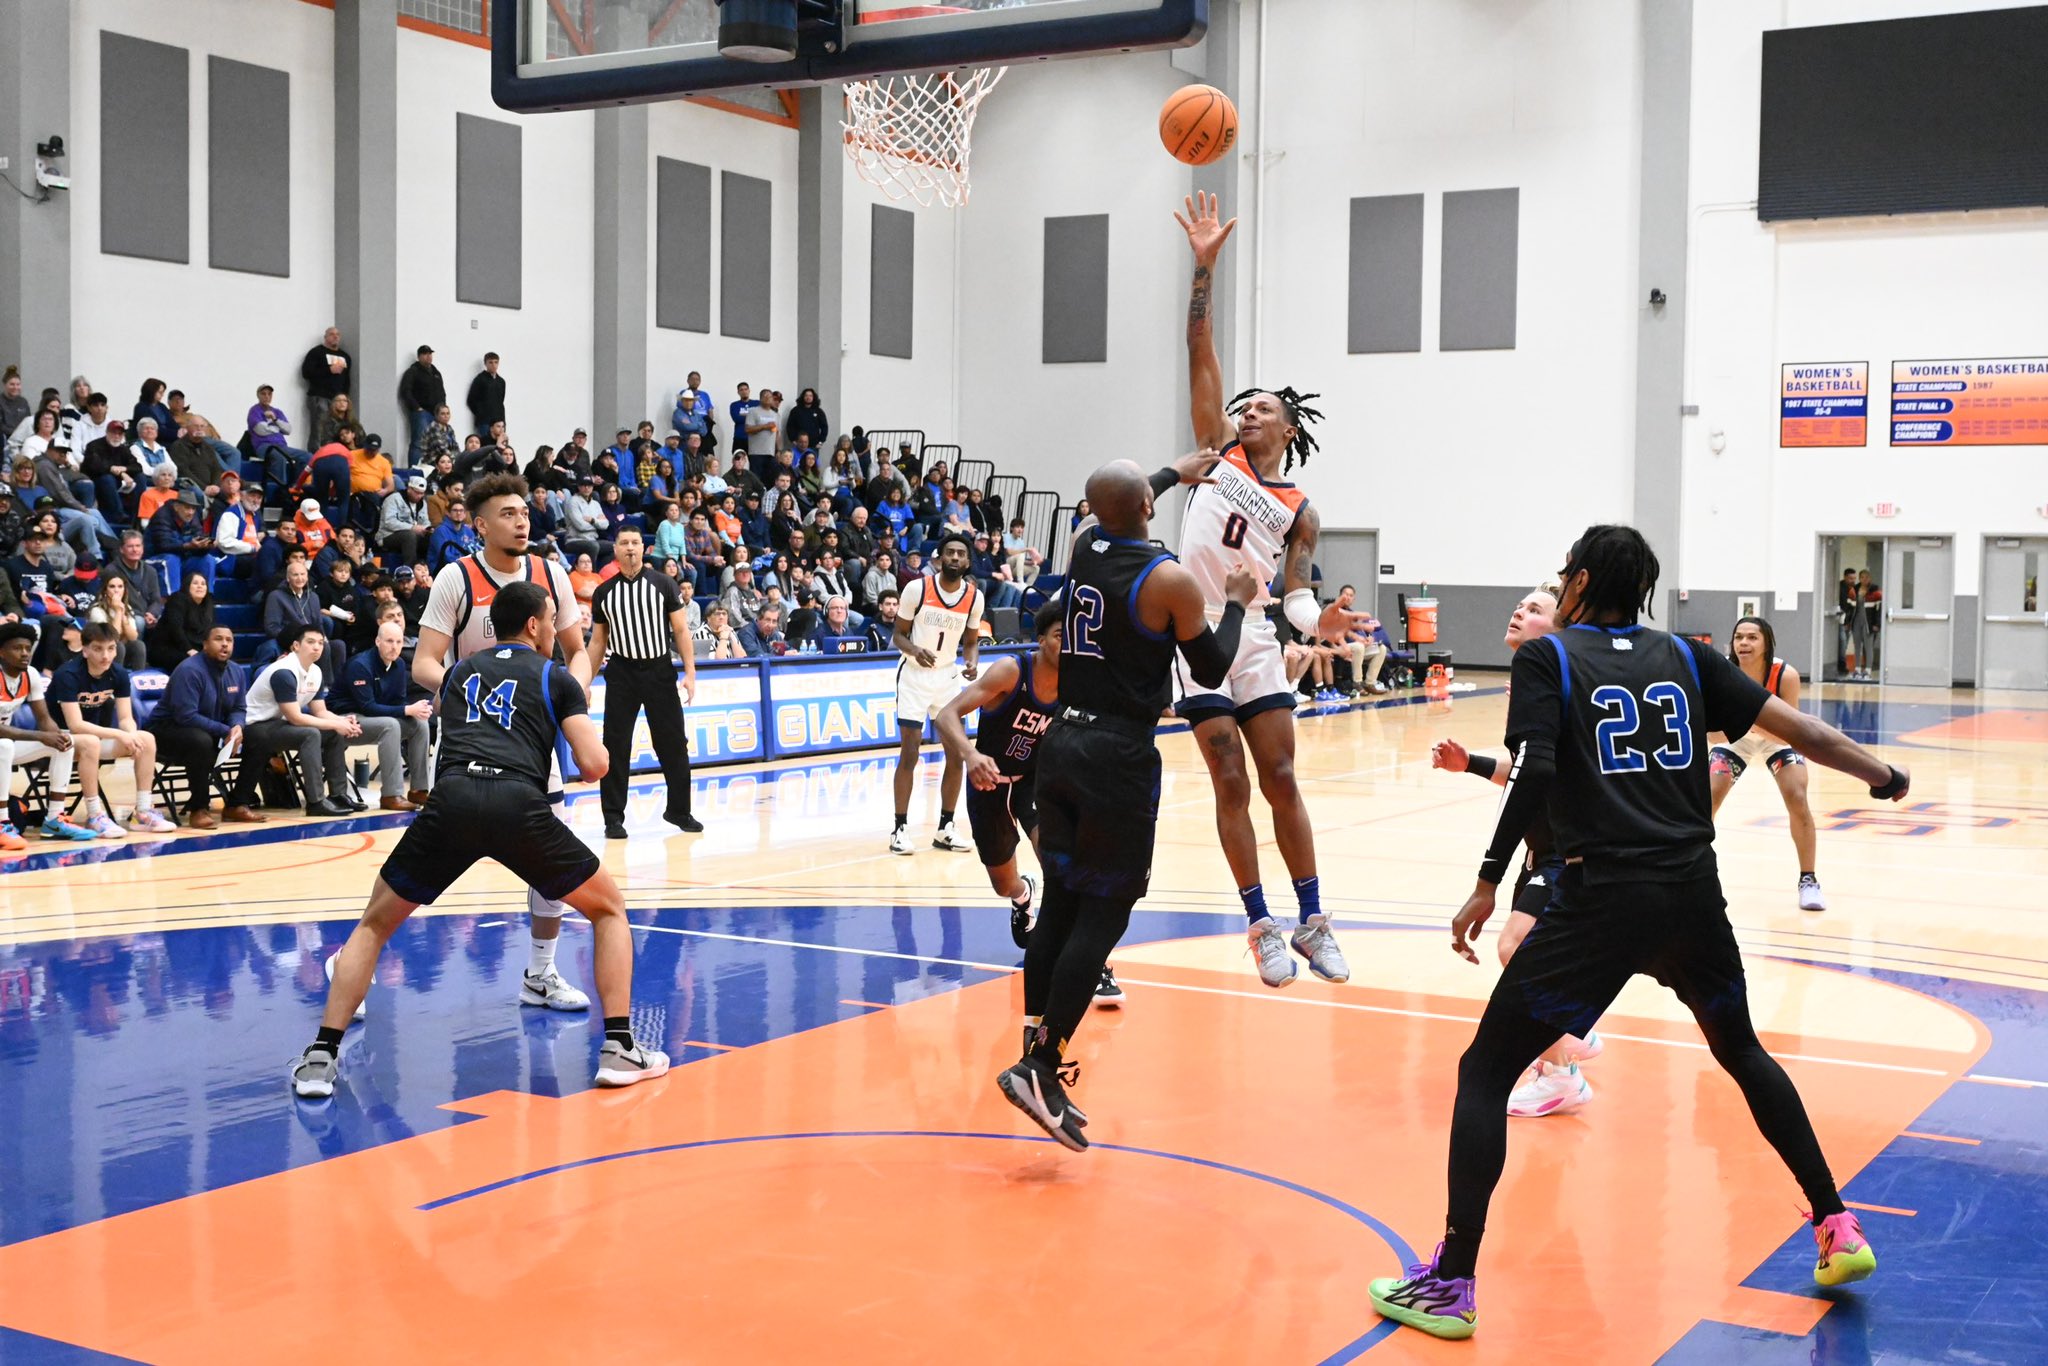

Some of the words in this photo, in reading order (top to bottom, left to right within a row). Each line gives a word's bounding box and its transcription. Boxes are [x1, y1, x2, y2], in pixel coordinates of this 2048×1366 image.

[1793, 367, 1853, 379] WOMEN'S
[1910, 365, 1972, 375] WOMEN'S
[1786, 381, 1862, 391] BASKETBALL
[1895, 383, 1917, 391] STATE
[1918, 382, 1963, 391] CHAMPIONS
[1802, 399, 1822, 407] STATE
[1822, 398, 1864, 407] CHAMPIONS
[1895, 402, 1917, 411] STATE
[1917, 402, 1939, 410] FINAL
[1894, 423, 1942, 431] CONFERENCE
[1894, 431, 1938, 439] CHAMPIONS
[1212, 472, 1287, 533] GIANTS
[1876, 503, 1893, 515] EXIT
[1221, 511, 1248, 550] 0
[936, 631, 945, 651] 1
[463, 672, 518, 730] 14
[777, 698, 897, 747] GIANT
[1012, 708, 1053, 735] CSM
[1591, 681, 1693, 774] 23
[1005, 734, 1036, 760] 15
